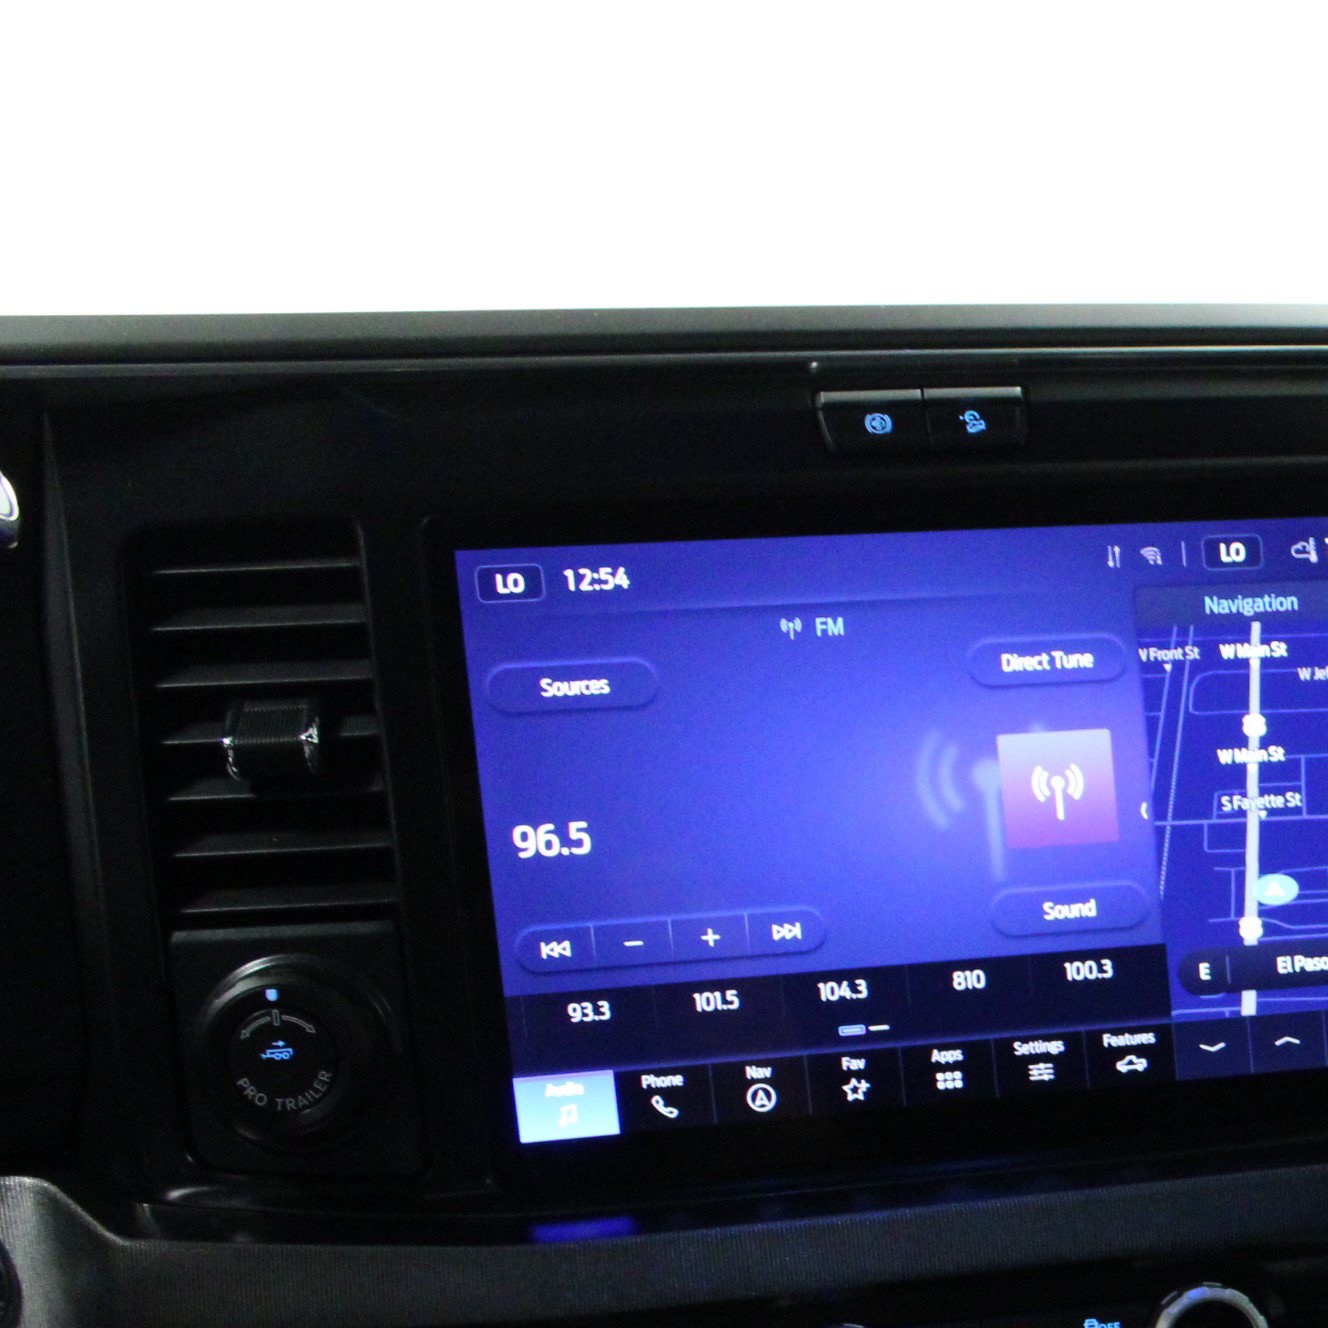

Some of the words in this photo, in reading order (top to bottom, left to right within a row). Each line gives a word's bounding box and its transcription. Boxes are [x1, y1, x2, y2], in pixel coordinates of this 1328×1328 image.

[1219, 542, 1246, 562] LO
[495, 573, 525, 594] LO
[563, 567, 630, 592] 12:54
[1204, 594, 1298, 617] Navigation
[815, 617, 844, 637] FM
[1149, 646, 1184, 662] Front
[1184, 645, 1200, 660] St
[1219, 643, 1235, 659] W
[1271, 641, 1288, 657] St
[1001, 652, 1050, 673] Direct
[1053, 650, 1094, 671] Tune
[1298, 666, 1312, 681] W
[540, 676, 611, 698] Sources
[1217, 748, 1233, 764] W
[1268, 745, 1286, 762] St
[1221, 796, 1232, 811] S
[1233, 793, 1284, 811] Fayette
[1285, 792, 1302, 808] St
[513, 821, 592, 859] 96.5
[1043, 898, 1097, 920] Sound
[1063, 960, 1113, 982] 100.3
[1199, 963, 1210, 980] E
[1277, 956, 1292, 974] El
[817, 979, 868, 1002] 104.3
[952, 969, 986, 991] 810
[568, 1001, 611, 1023] 93.3
[693, 990, 740, 1013] 101.5
[1013, 1039, 1065, 1057] Settings
[1103, 1031, 1155, 1048] Features
[841, 1056, 865, 1072] Fav
[931, 1048, 963, 1065] Apps
[641, 1072, 684, 1089] Phone
[746, 1065, 772, 1080] Nav
[236, 1077, 268, 1106] PRO
[276, 1070, 334, 1111] TRAILER
